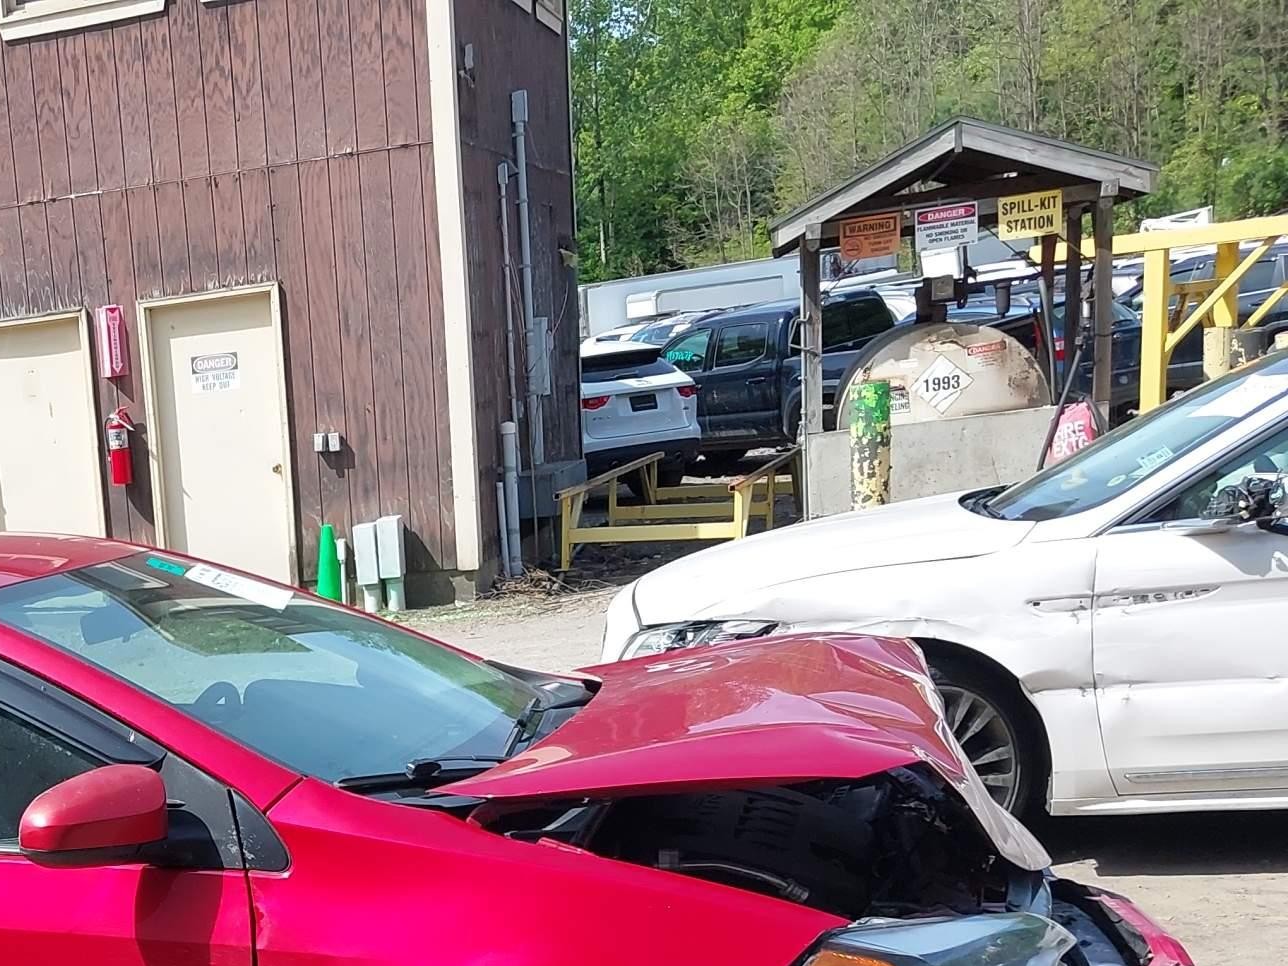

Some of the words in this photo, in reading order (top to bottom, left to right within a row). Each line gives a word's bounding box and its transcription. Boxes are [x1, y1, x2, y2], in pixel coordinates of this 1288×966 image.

[1002, 195, 1058, 216] SPILL-KIT
[927, 208, 965, 221] DANGER
[848, 220, 891, 234] WARNING
[1006, 213, 1054, 233] STATION
[197, 357, 232, 369] DANGER
[923, 374, 960, 393] 1993
